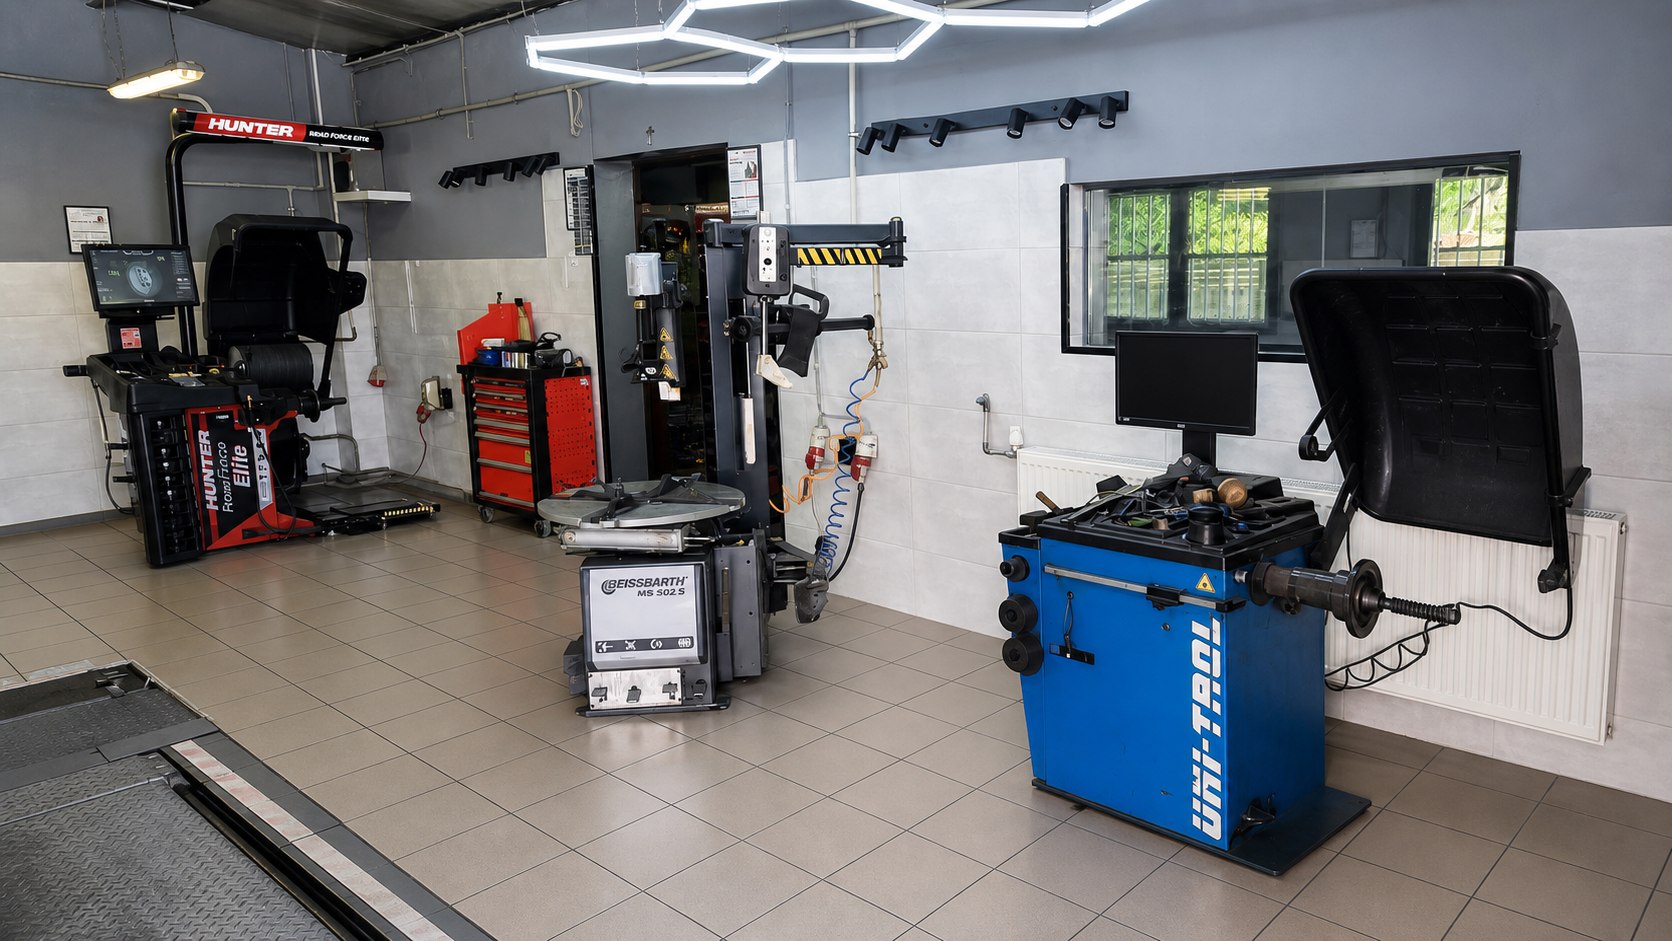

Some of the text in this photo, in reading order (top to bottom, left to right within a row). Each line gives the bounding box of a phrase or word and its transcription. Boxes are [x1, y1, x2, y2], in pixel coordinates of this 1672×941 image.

[208, 117, 294, 138] HUNTER
[198, 429, 219, 511] HUNTER
[231, 445, 251, 488] Elite
[607, 576, 686, 589] BEISSBARTH
[637, 589, 654, 597] MS
